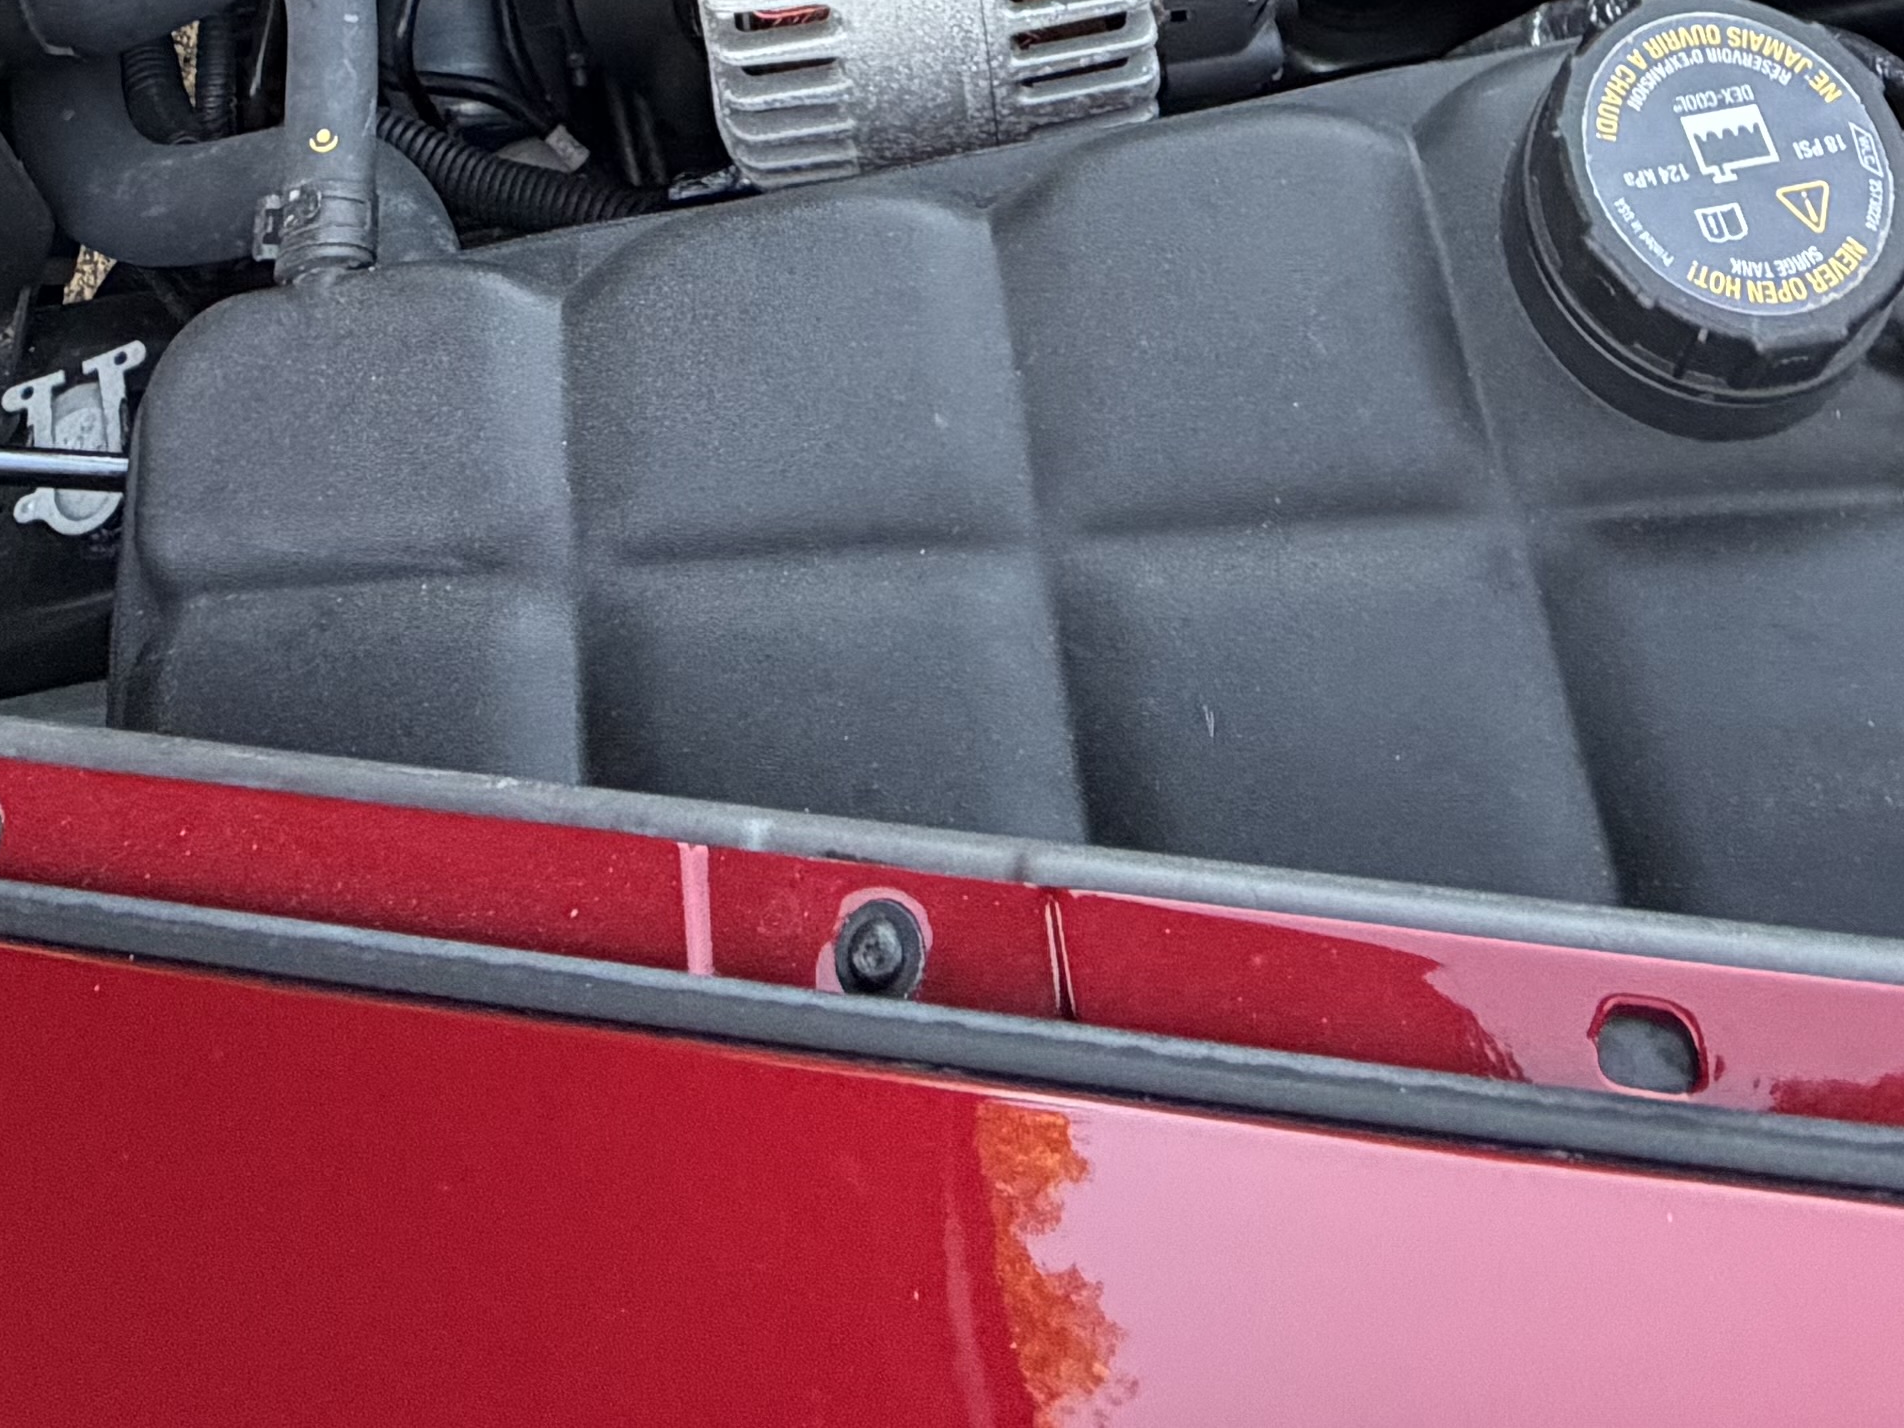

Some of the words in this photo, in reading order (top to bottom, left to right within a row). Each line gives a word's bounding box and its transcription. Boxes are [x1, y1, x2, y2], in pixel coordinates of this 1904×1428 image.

[1643, 24, 1721, 58] OUVRIR
[1726, 26, 1813, 75] JAMAIS
[1596, 64, 1637, 142] CHAUD!
[1792, 138, 1823, 160] PSI
[1824, 133, 1847, 155] 18
[1623, 168, 1656, 187] kPa
[1658, 163, 1689, 184] 124
[1730, 257, 1774, 278] TANK
[1775, 246, 1824, 277] SURGE
[1812, 236, 1867, 293] NEVER
[1687, 260, 1741, 297] HOT!
[1746, 282, 1808, 304] OPEN
